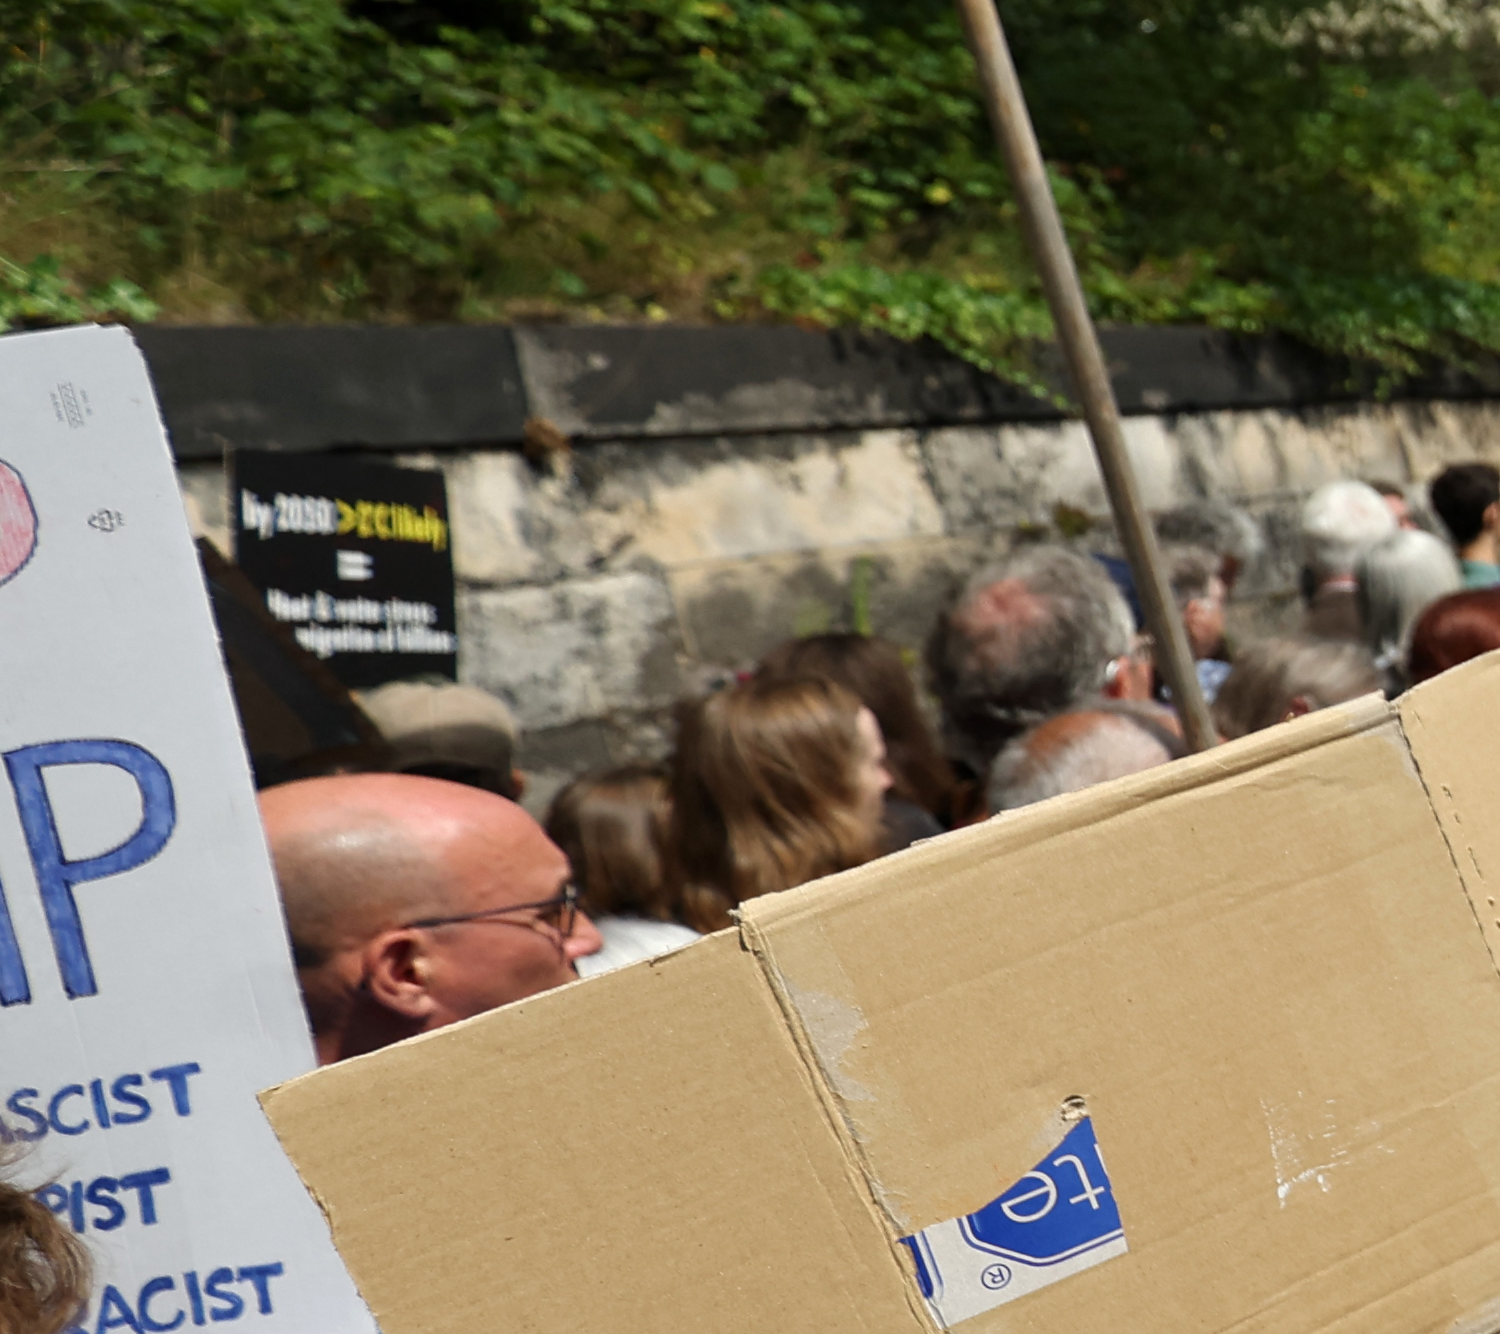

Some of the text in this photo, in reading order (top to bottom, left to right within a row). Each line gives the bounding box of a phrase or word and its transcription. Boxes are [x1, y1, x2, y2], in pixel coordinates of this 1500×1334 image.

[0, 1062, 200, 1145] SCIST
[33, 1167, 170, 1235] PIST
[1000, 1143, 1113, 1224] te
